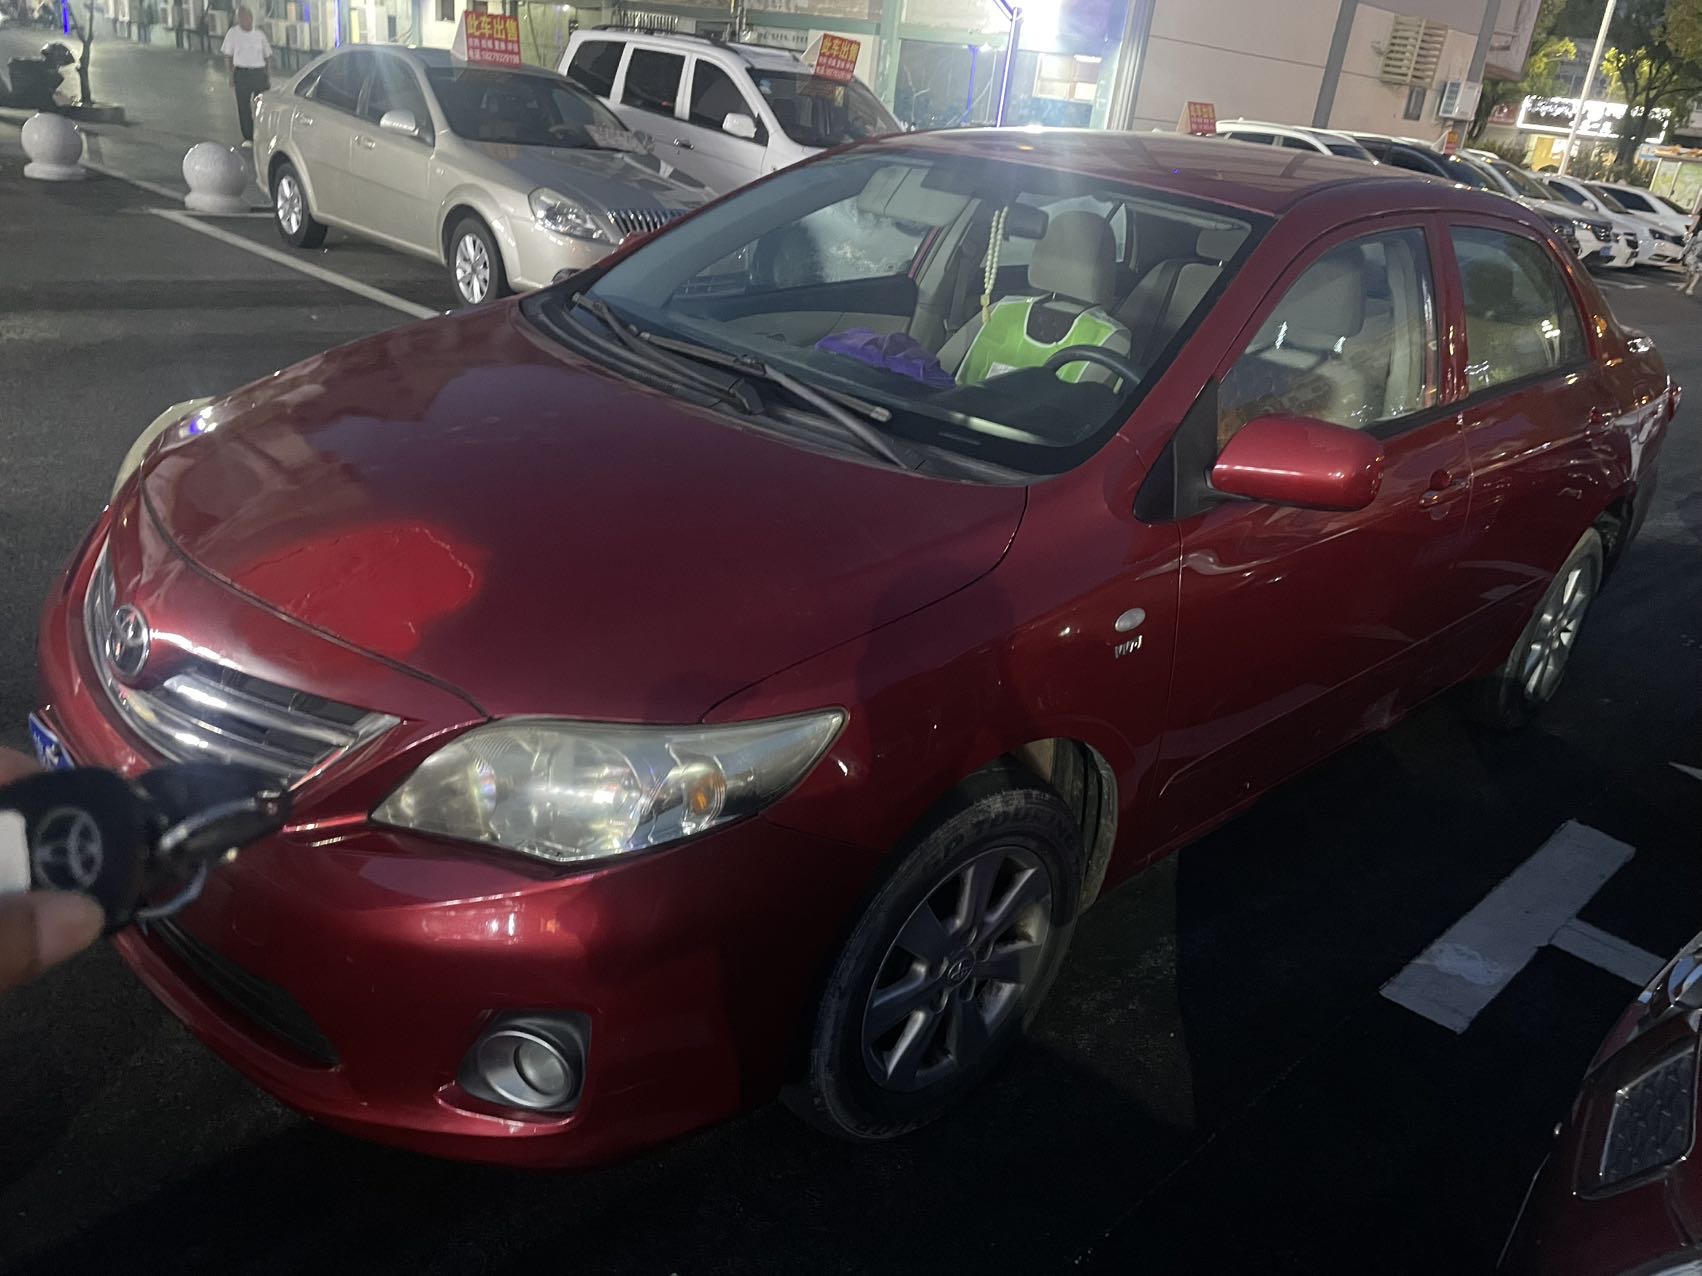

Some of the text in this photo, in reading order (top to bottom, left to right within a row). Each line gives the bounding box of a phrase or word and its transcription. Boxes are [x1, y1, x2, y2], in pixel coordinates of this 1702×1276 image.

[466, 13, 518, 41] 此车出售
[820, 36, 859, 63] 此车出售
